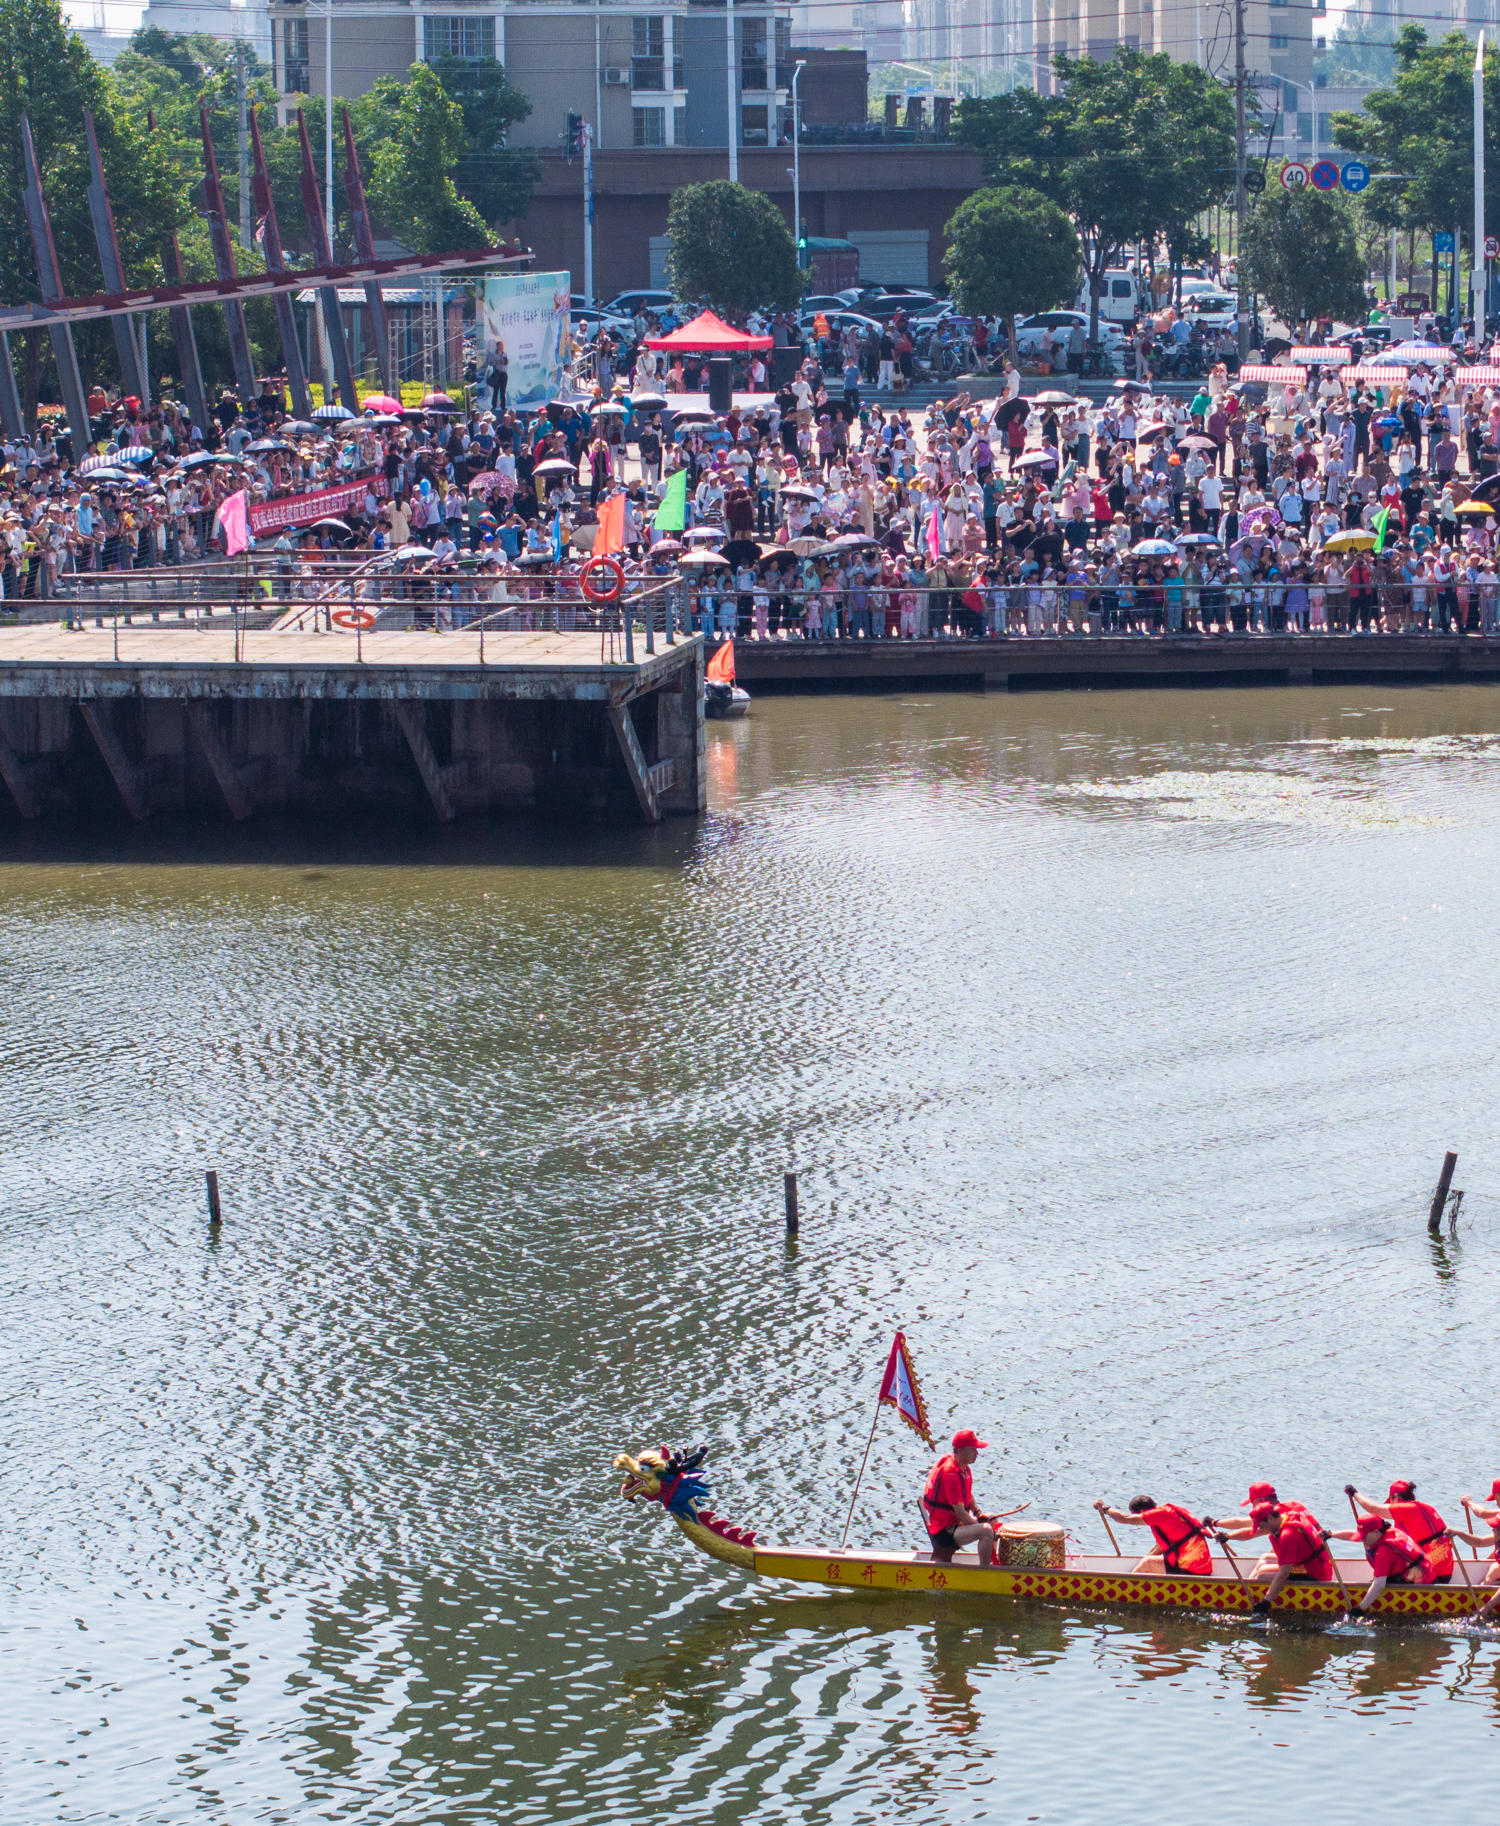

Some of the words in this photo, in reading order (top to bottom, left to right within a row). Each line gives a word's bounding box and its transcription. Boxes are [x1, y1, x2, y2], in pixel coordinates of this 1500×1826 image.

[1286, 170, 1304, 183] 40
[827, 1563, 948, 1588] 经开泳协
